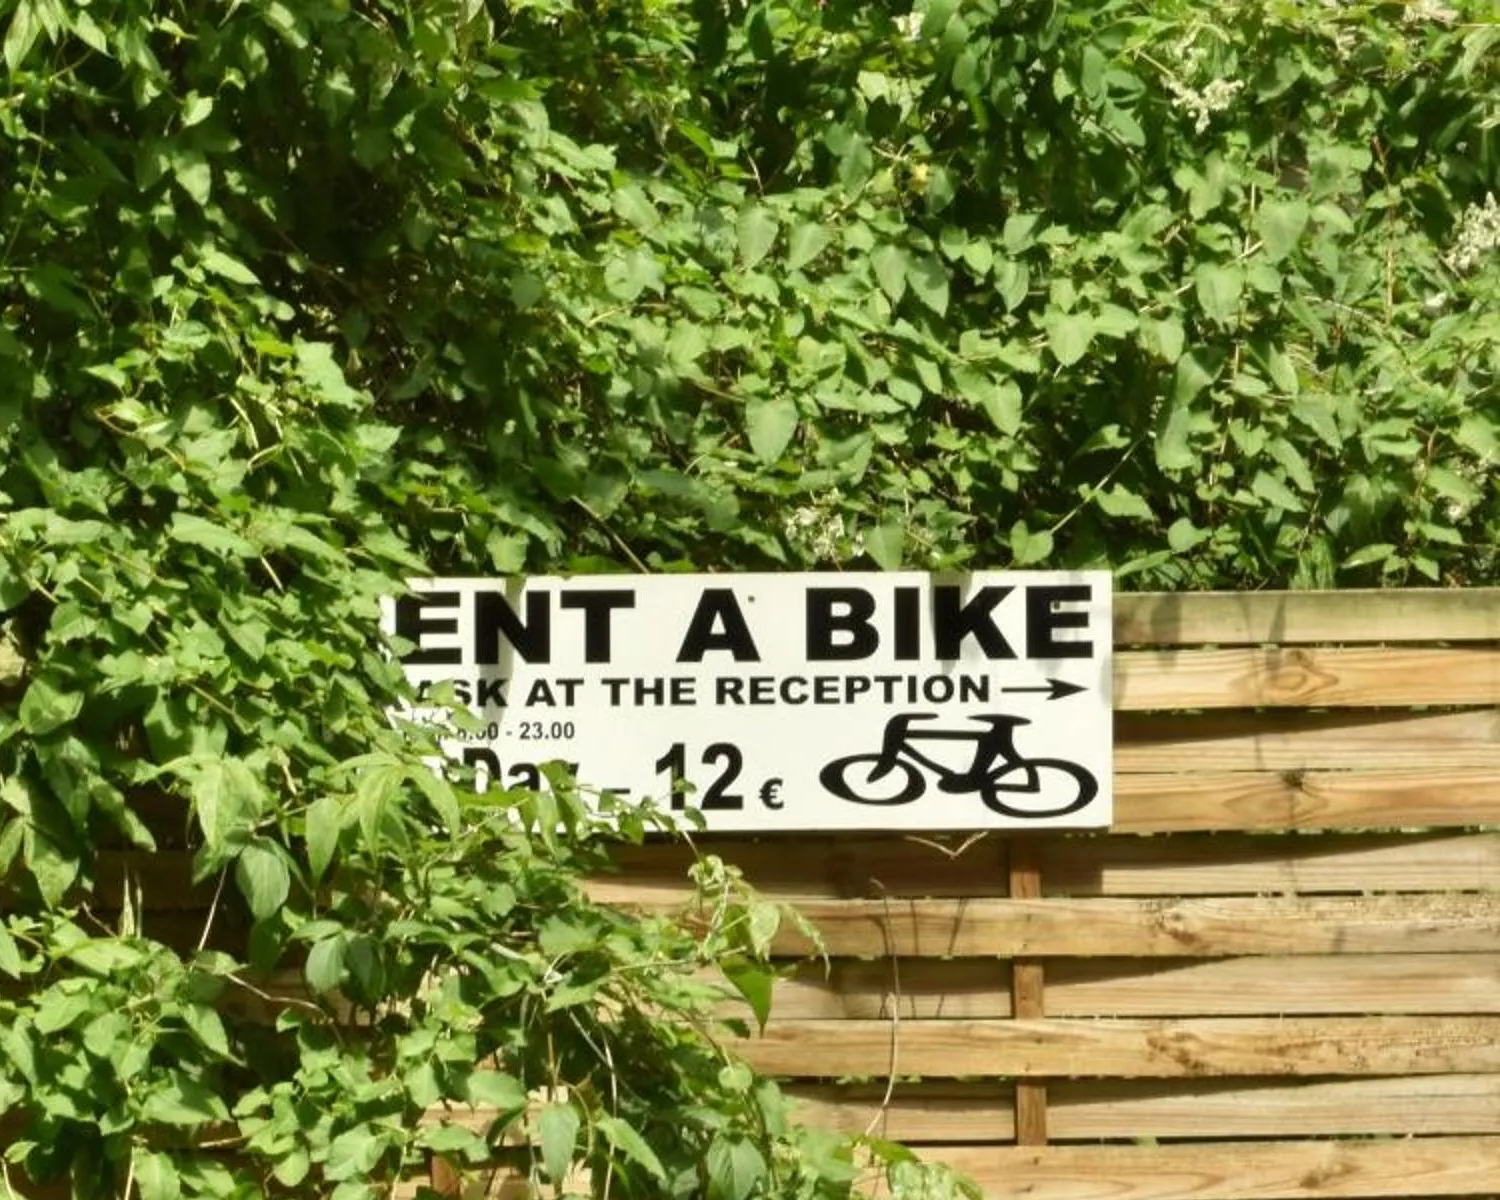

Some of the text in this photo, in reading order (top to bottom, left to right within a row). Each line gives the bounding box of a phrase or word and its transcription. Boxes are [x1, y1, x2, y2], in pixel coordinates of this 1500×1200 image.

[395, 585, 1094, 665] ENT A BIKE
[525, 678, 584, 706] AT
[601, 677, 697, 705] THE
[715, 674, 989, 705] RECEPTION
[519, 721, 575, 740] 23.00
[463, 747, 579, 793] Da
[655, 742, 743, 810] 12
[758, 777, 784, 810] €
